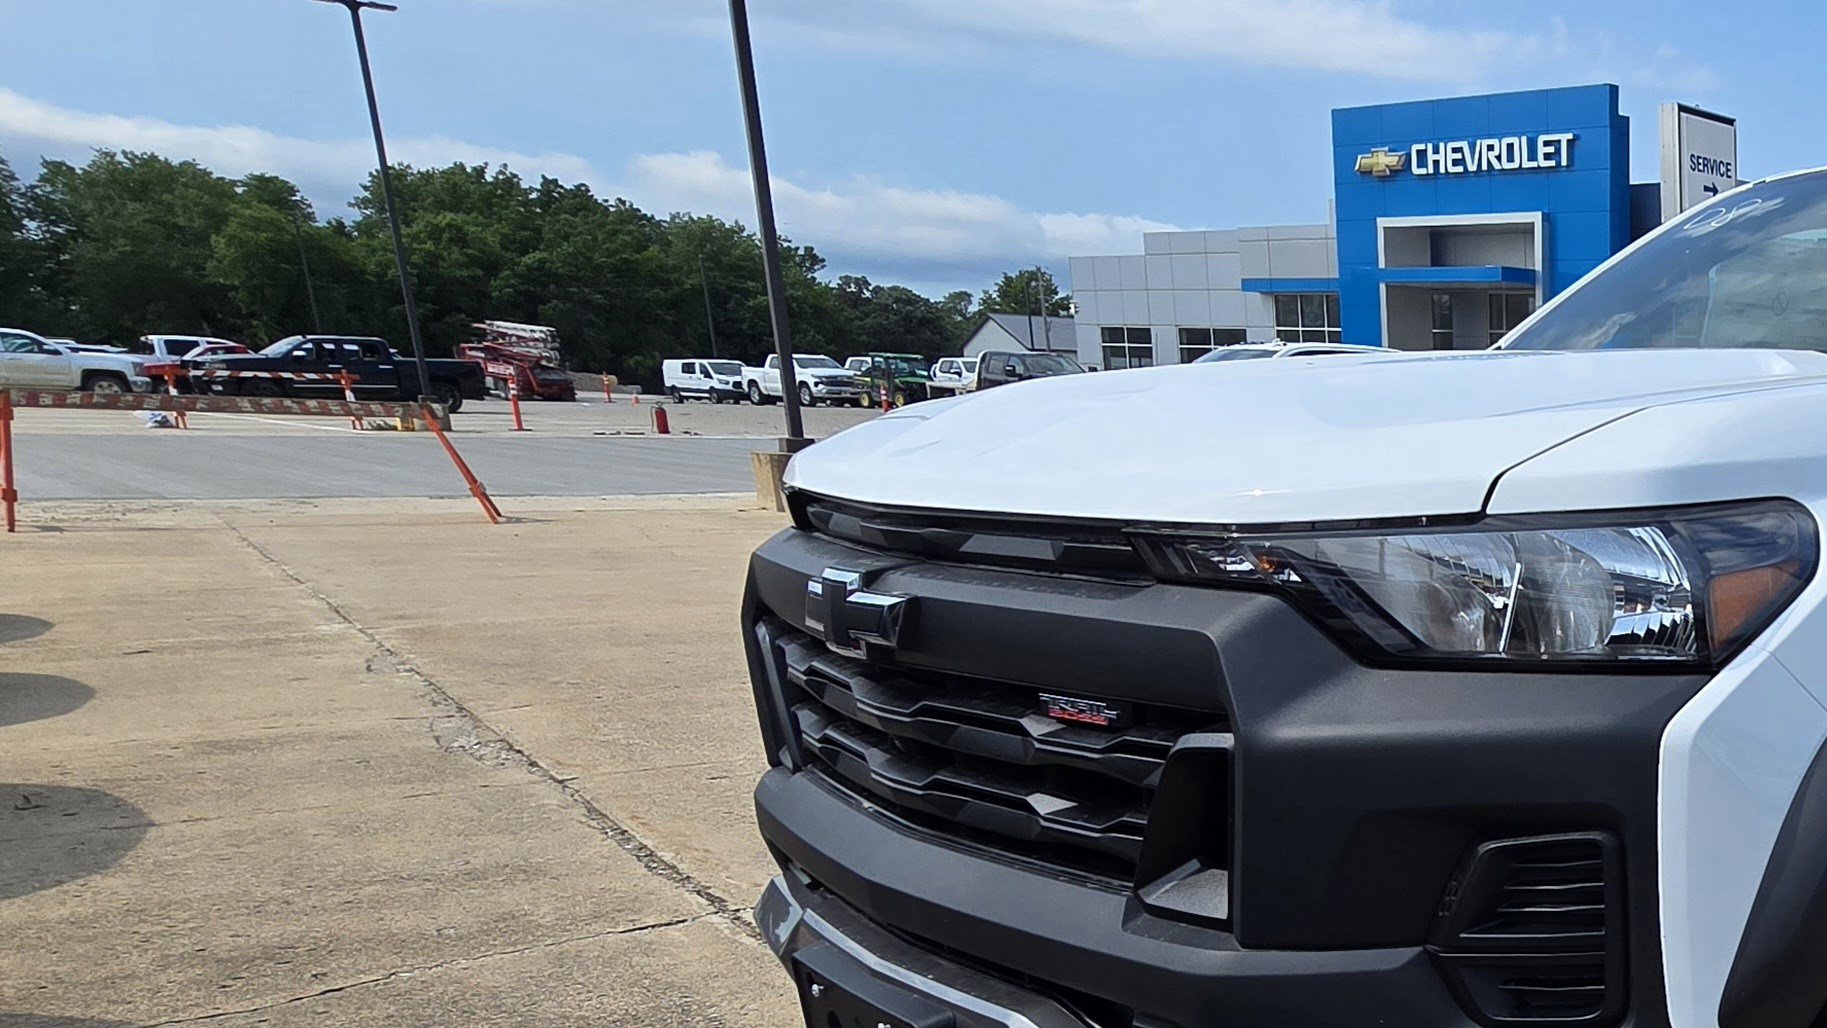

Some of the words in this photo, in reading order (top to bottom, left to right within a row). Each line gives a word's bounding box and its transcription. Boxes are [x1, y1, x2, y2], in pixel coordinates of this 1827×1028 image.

[1410, 133, 1574, 175] CHEVROLET
[1689, 153, 1732, 179] SERVICE
[1039, 693, 1120, 719] TRAIL
[1048, 707, 1109, 726] BOSS
